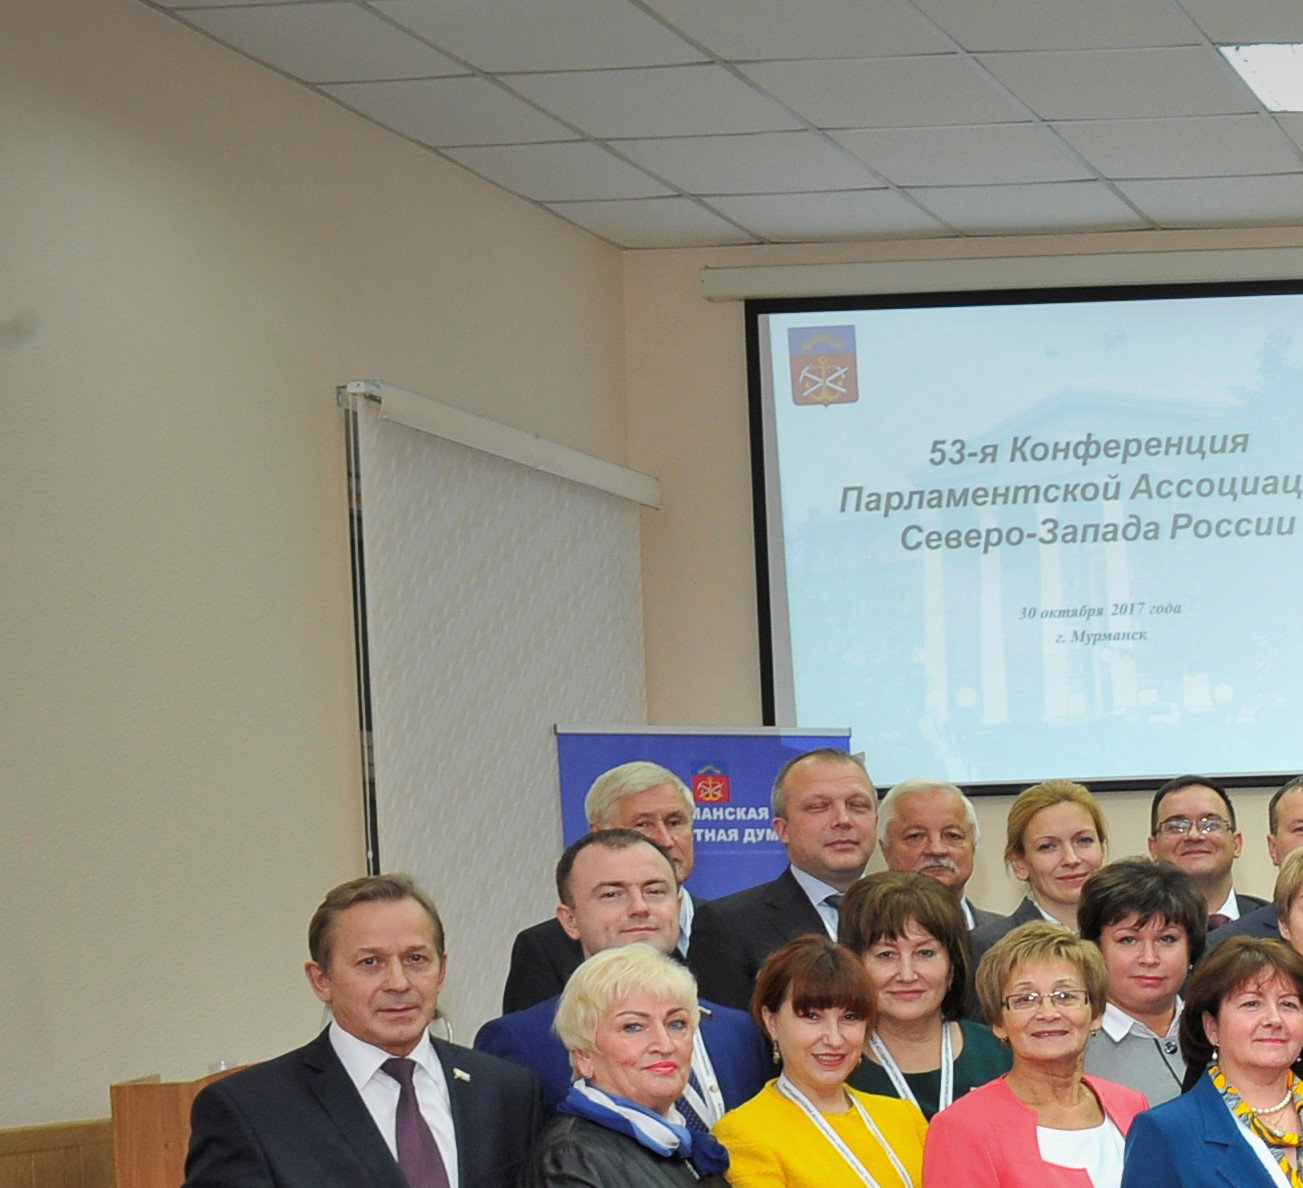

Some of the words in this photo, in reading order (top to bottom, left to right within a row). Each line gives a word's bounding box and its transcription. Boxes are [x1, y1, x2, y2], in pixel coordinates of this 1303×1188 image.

[929, 439, 998, 466] 53-я
[1009, 432, 1249, 466] Конференция
[839, 473, 1121, 517] Парламентской
[901, 514, 1160, 554] Северо-Запада
[1170, 513, 1296, 540] России
[1019, 607, 1036, 620] 30
[1040, 605, 1104, 620] октября
[1111, 602, 1145, 616] 2017
[1148, 603, 1181, 614] года
[1056, 633, 1065, 643] г.
[1071, 630, 1147, 645] Мурманск
[692, 806, 769, 820] МАНСКАЯ
[743, 828, 779, 844] ДУМ
